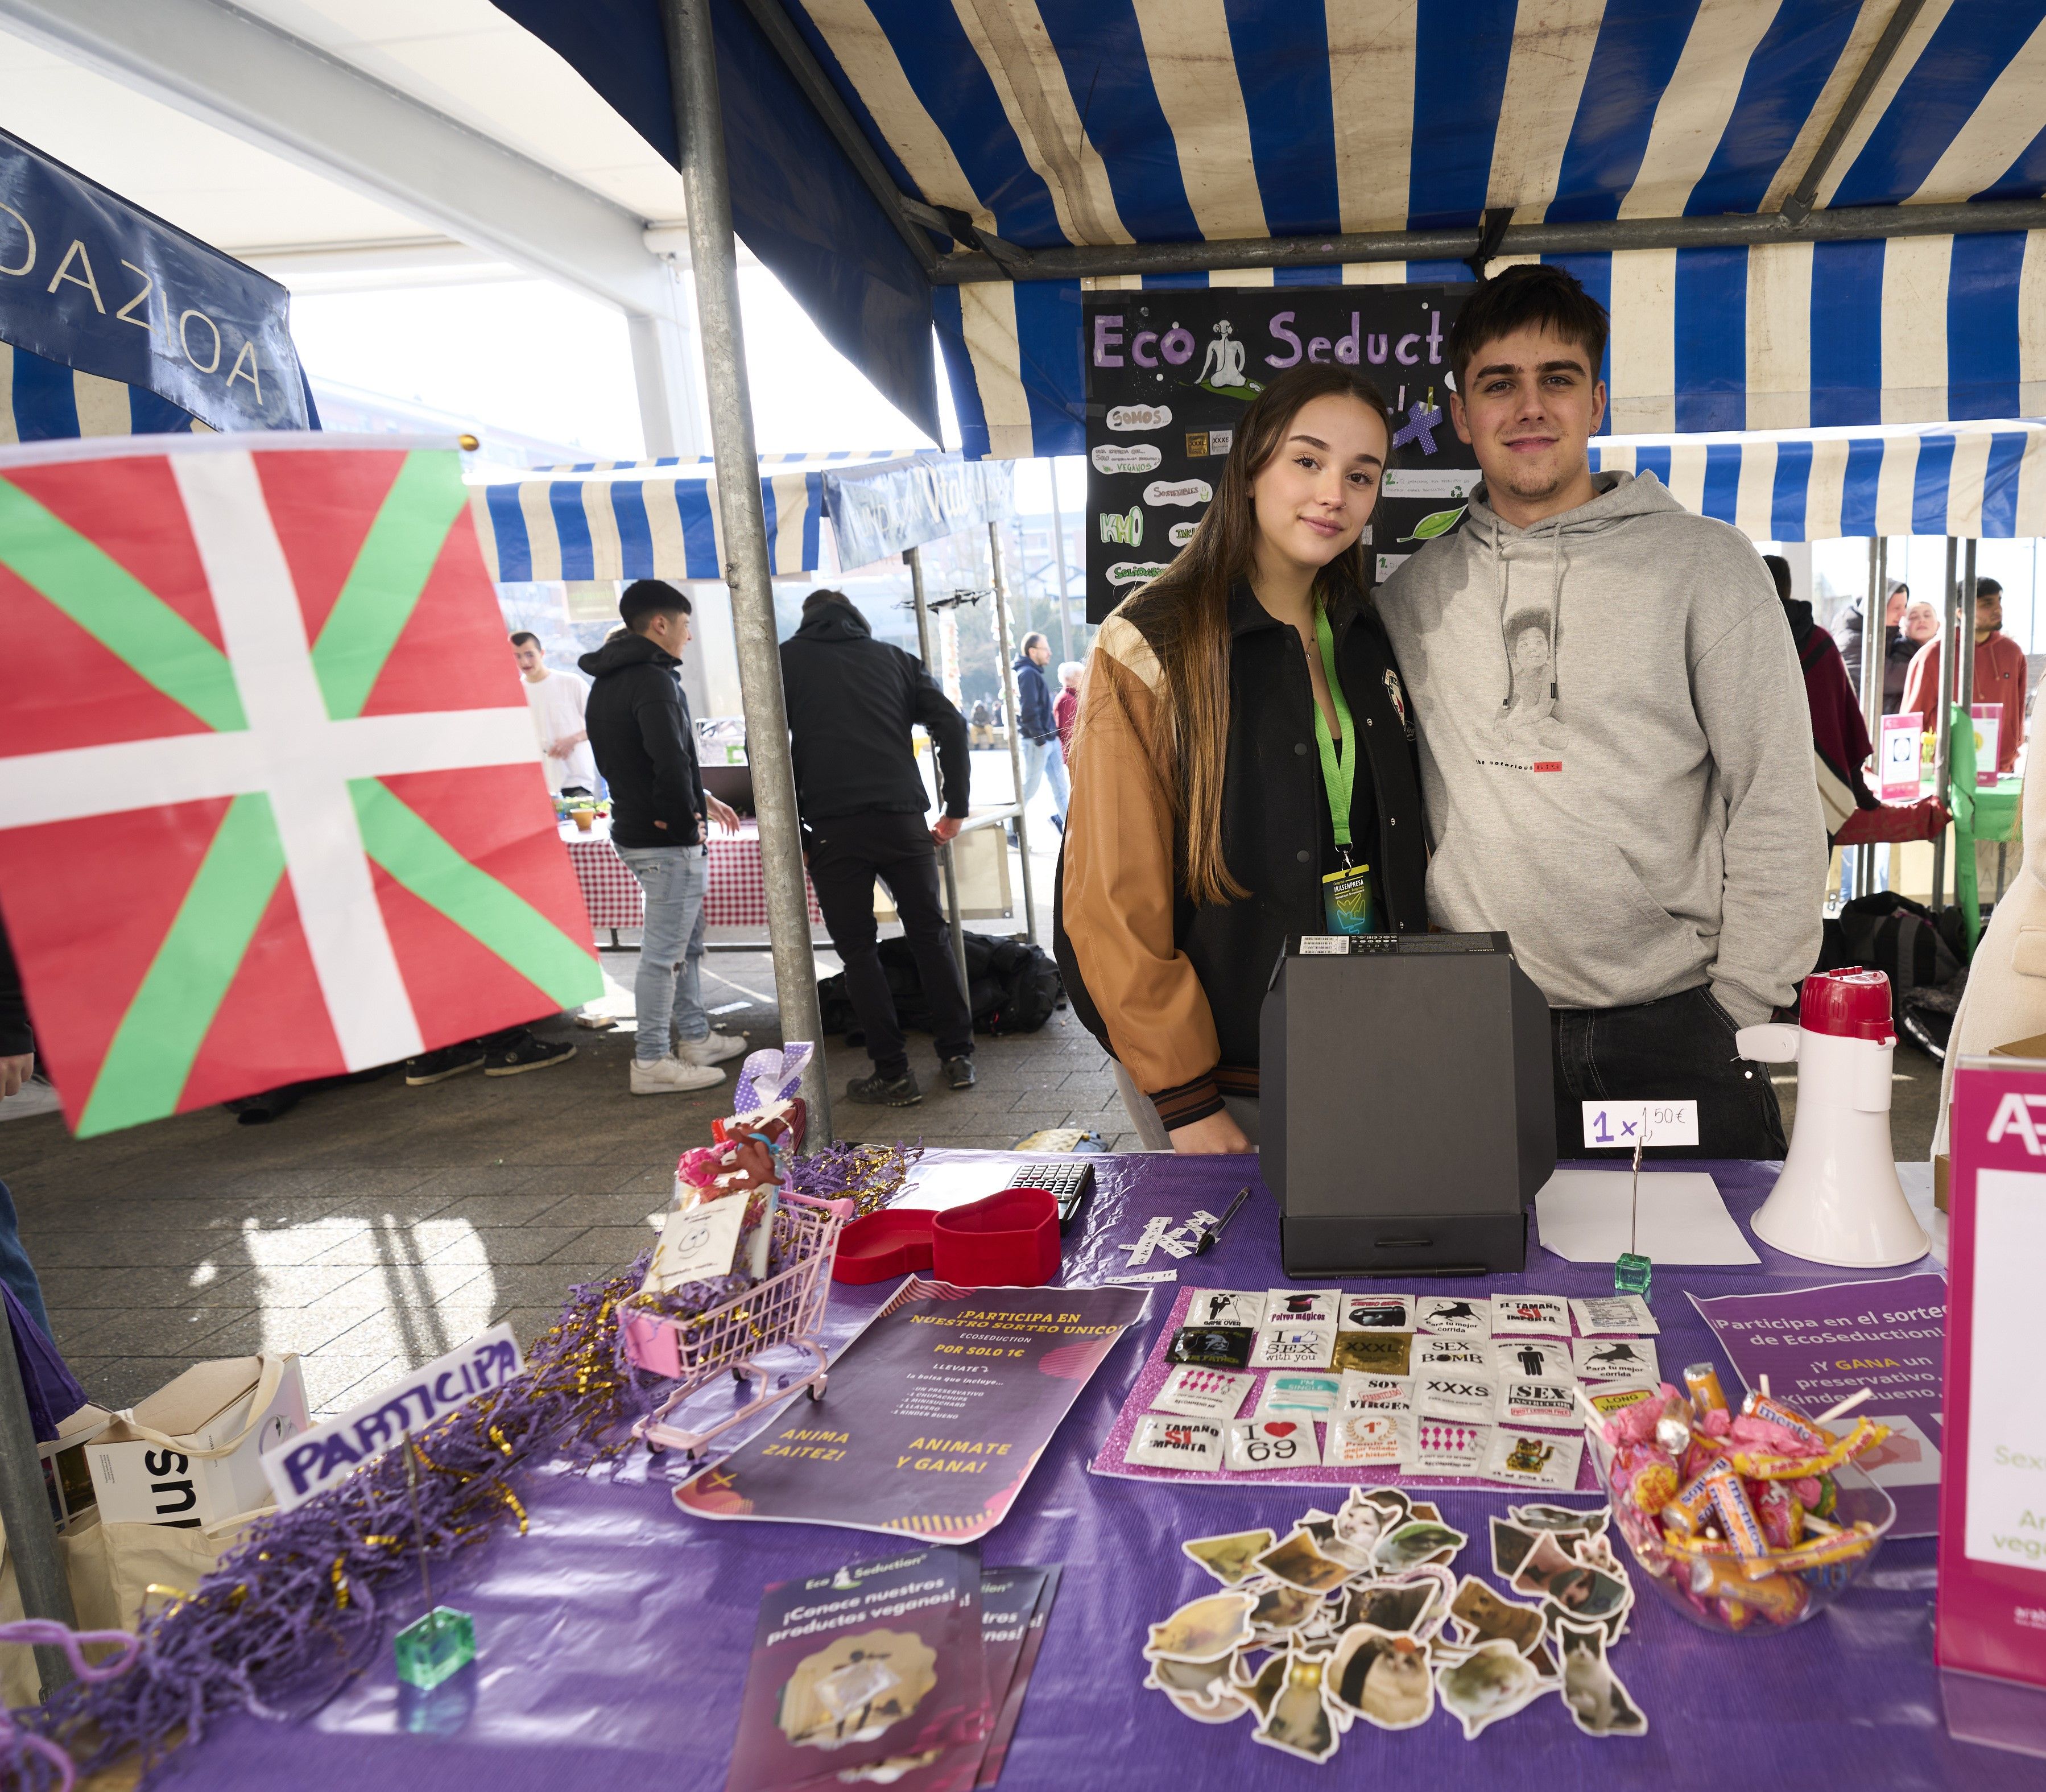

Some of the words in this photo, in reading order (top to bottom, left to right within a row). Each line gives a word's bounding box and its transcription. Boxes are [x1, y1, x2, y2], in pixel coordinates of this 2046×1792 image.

[1093, 315, 1194, 368] Eco
[1264, 311, 1444, 368] Seduct
[1490, 761, 1533, 770] notorious
[1334, 879, 1364, 893] IKASENPRESA
[1515, 1303, 1561, 1311] TAMAÑO
[957, 1311, 1052, 1323] ¡PARTICIPA
[1057, 1314, 1081, 1323] EN
[1271, 1314, 1294, 1322] Polvos
[1295, 1312, 1325, 1321] mágicos
[1824, 1317, 1851, 1327] en
[1858, 1311, 1879, 1324] el
[910, 1315, 989, 1329] NUESTRO
[992, 1322, 1059, 1333] SORTEO
[960, 1333, 1032, 1343] ECOSEDUCTION
[1272, 1330, 1288, 1343] I
[1750, 1335, 1779, 1345] de
[1783, 1327, 1944, 1345] EcoSeduction!
[933, 1344, 964, 1355] POR
[968, 1346, 1003, 1357] SOLO
[1008, 1349, 1025, 1357] 1€
[1266, 1344, 1318, 1355] SEX
[1344, 1343, 1398, 1352] XXXL
[1432, 1342, 1470, 1351] SEX
[1422, 1354, 1483, 1364] BOMB
[1811, 1361, 1834, 1374] ¡Y
[1836, 1357, 1901, 1370] GANA
[1903, 1357, 1933, 1366] un
[933, 1364, 979, 1372] LLEVATE
[928, 1387, 984, 1397] PRESERVATIVO
[1426, 1381, 1489, 1397] XXXS
[1516, 1385, 1566, 1399] SEX
[911, 1398, 966, 1407] MINISUCHARD
[916, 1393, 968, 1402] CHUPACHUPS
[1511, 1398, 1570, 1408] INSTRUCTOR
[1606, 1395, 1639, 1403] LONG
[1350, 1400, 1410, 1409] VIRGEN
[282, 1340, 517, 1496] PARTICIPA
[779, 1428, 850, 1443] ANIMA
[1166, 1423, 1219, 1436] TAMAÑO
[1242, 1423, 1260, 1440] I
[762, 1444, 846, 1461] ZAITEZ!
[909, 1437, 1012, 1455] ANIMATE
[1150, 1440, 1206, 1452] IMPORTA
[1247, 1439, 1296, 1461] 69
[1994, 1444, 2046, 1469] Sex
[896, 1456, 912, 1469] Y
[914, 1457, 987, 1473] GANA!
[805, 1578, 830, 1591] Eco
[865, 1578, 944, 1605] nuestros
[767, 1612, 866, 1646] productos
[871, 1588, 956, 1618] veganos!
